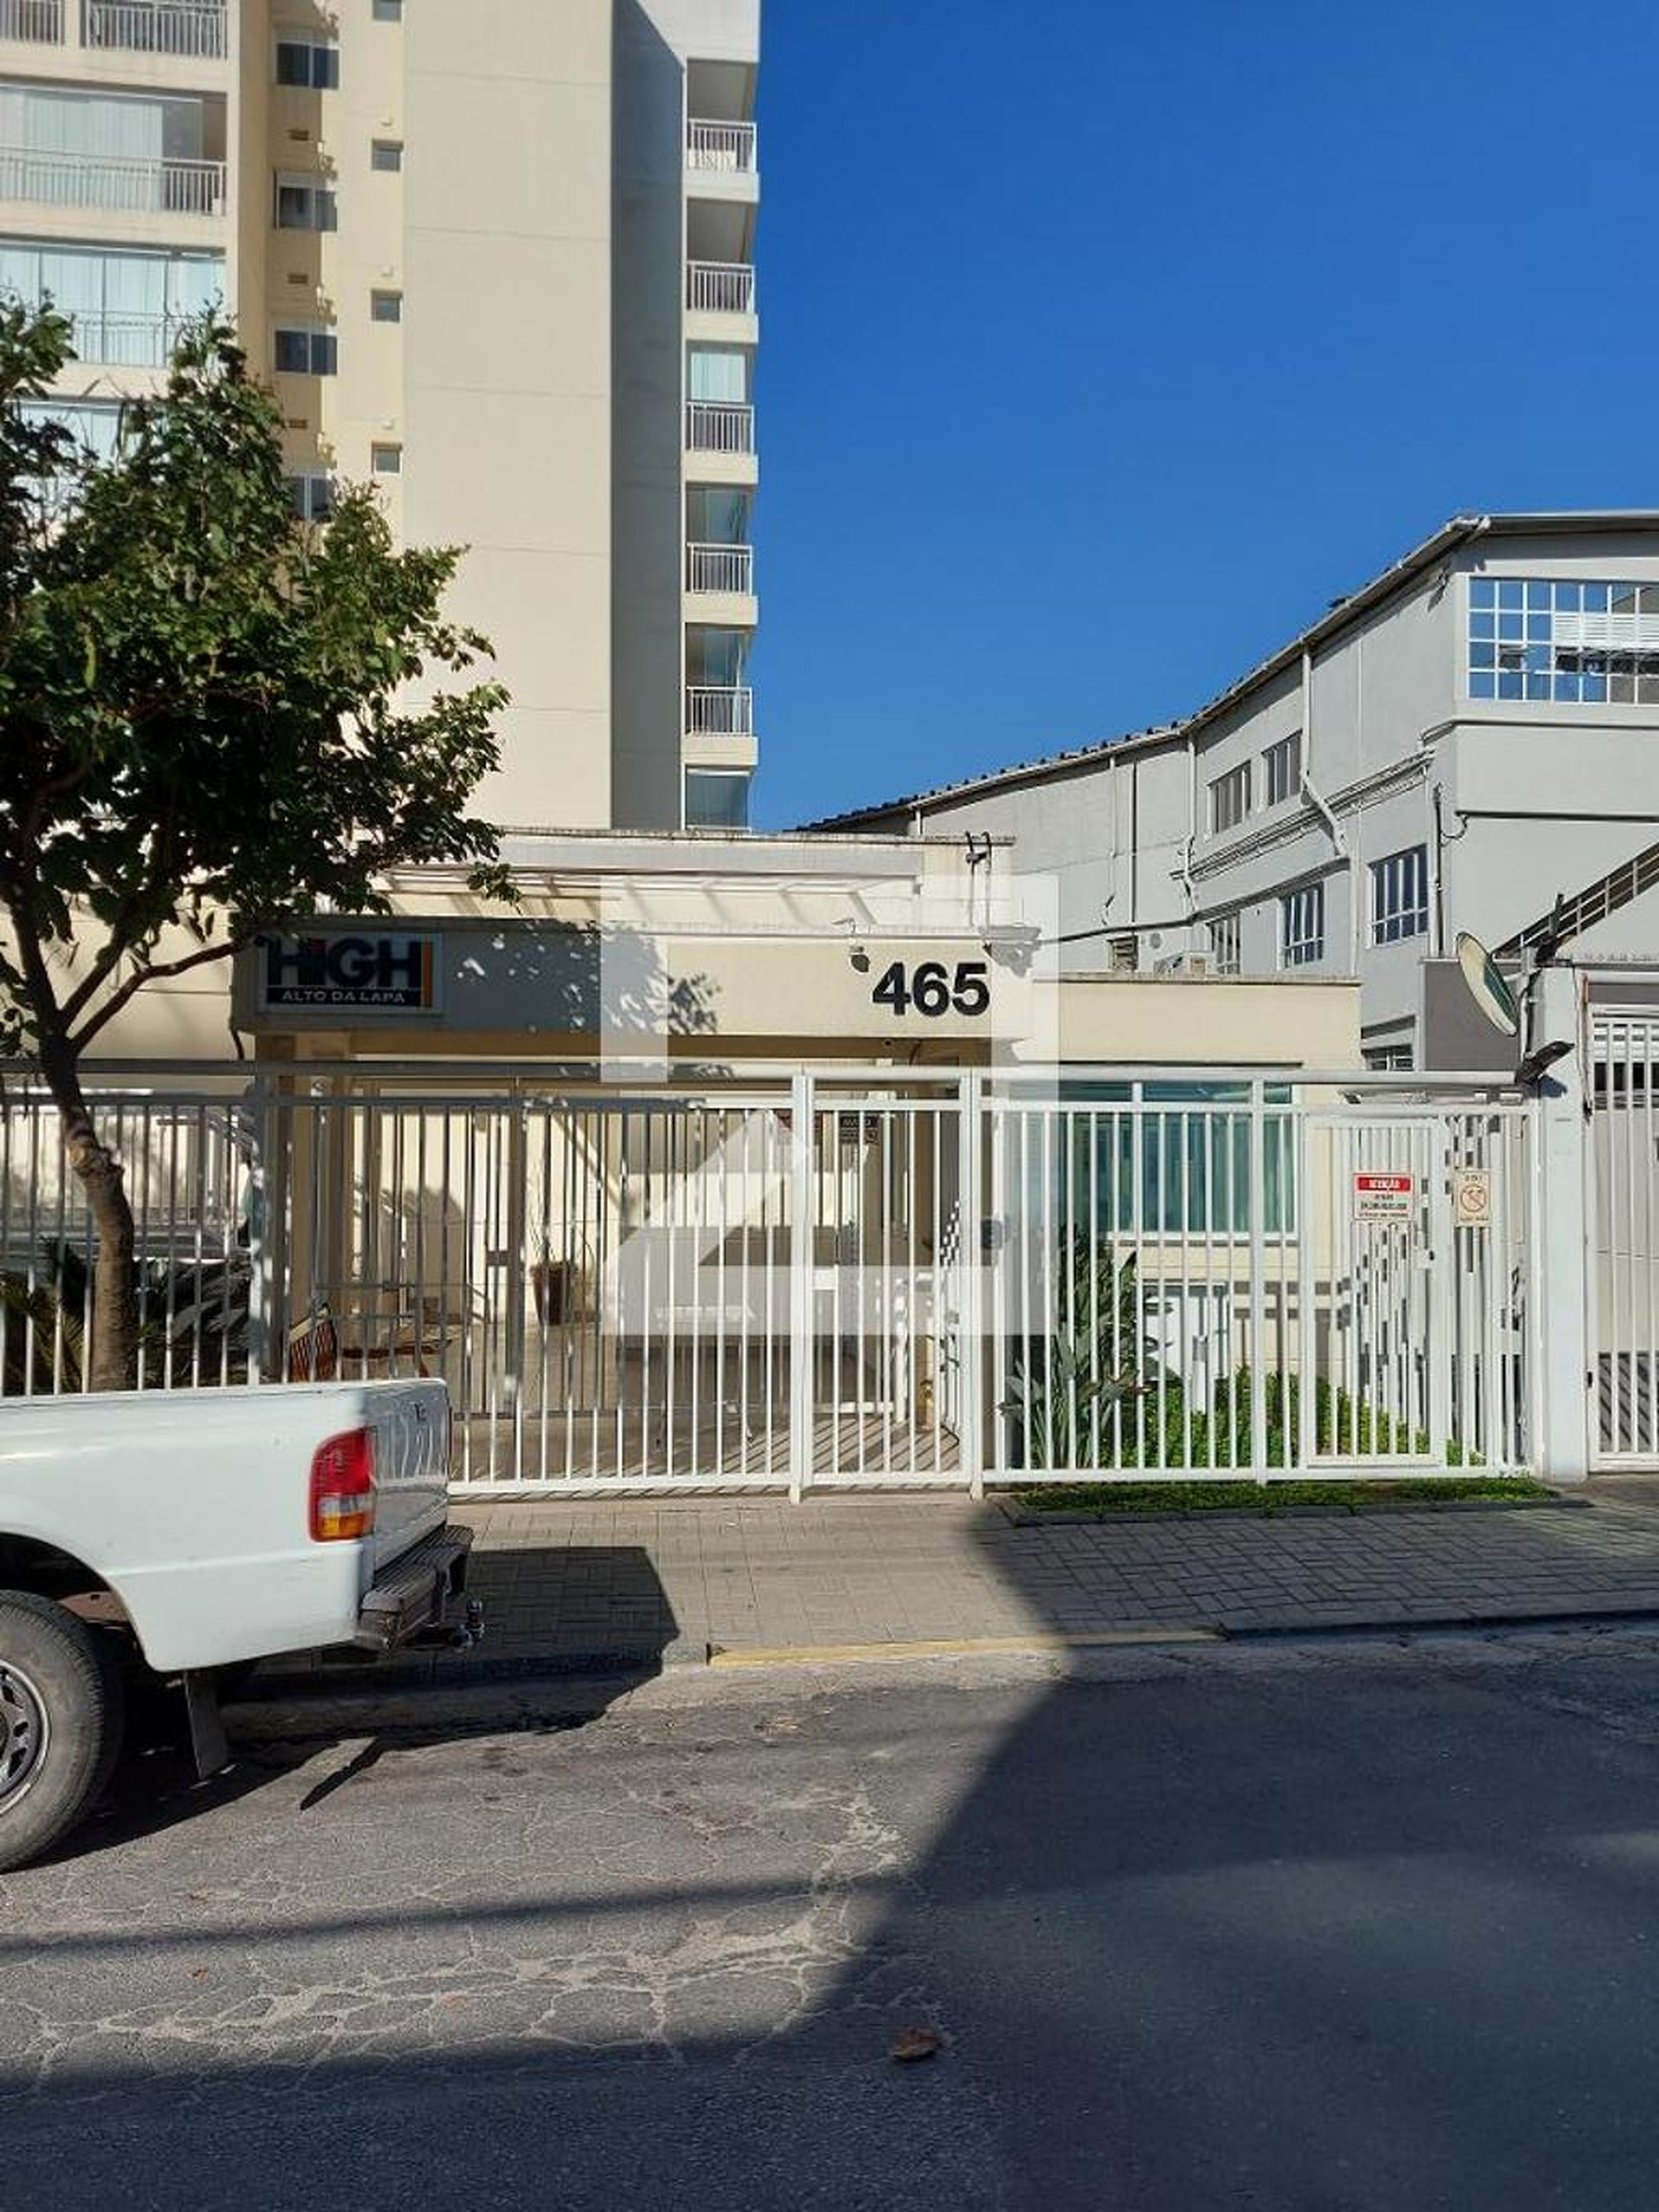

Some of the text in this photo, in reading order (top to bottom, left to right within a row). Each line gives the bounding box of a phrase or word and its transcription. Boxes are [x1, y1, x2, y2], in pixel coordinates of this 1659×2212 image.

[267, 937, 421, 986] HIGH
[282, 990, 405, 1003] ALTO DA LAPA
[873, 961, 990, 1015] 465
